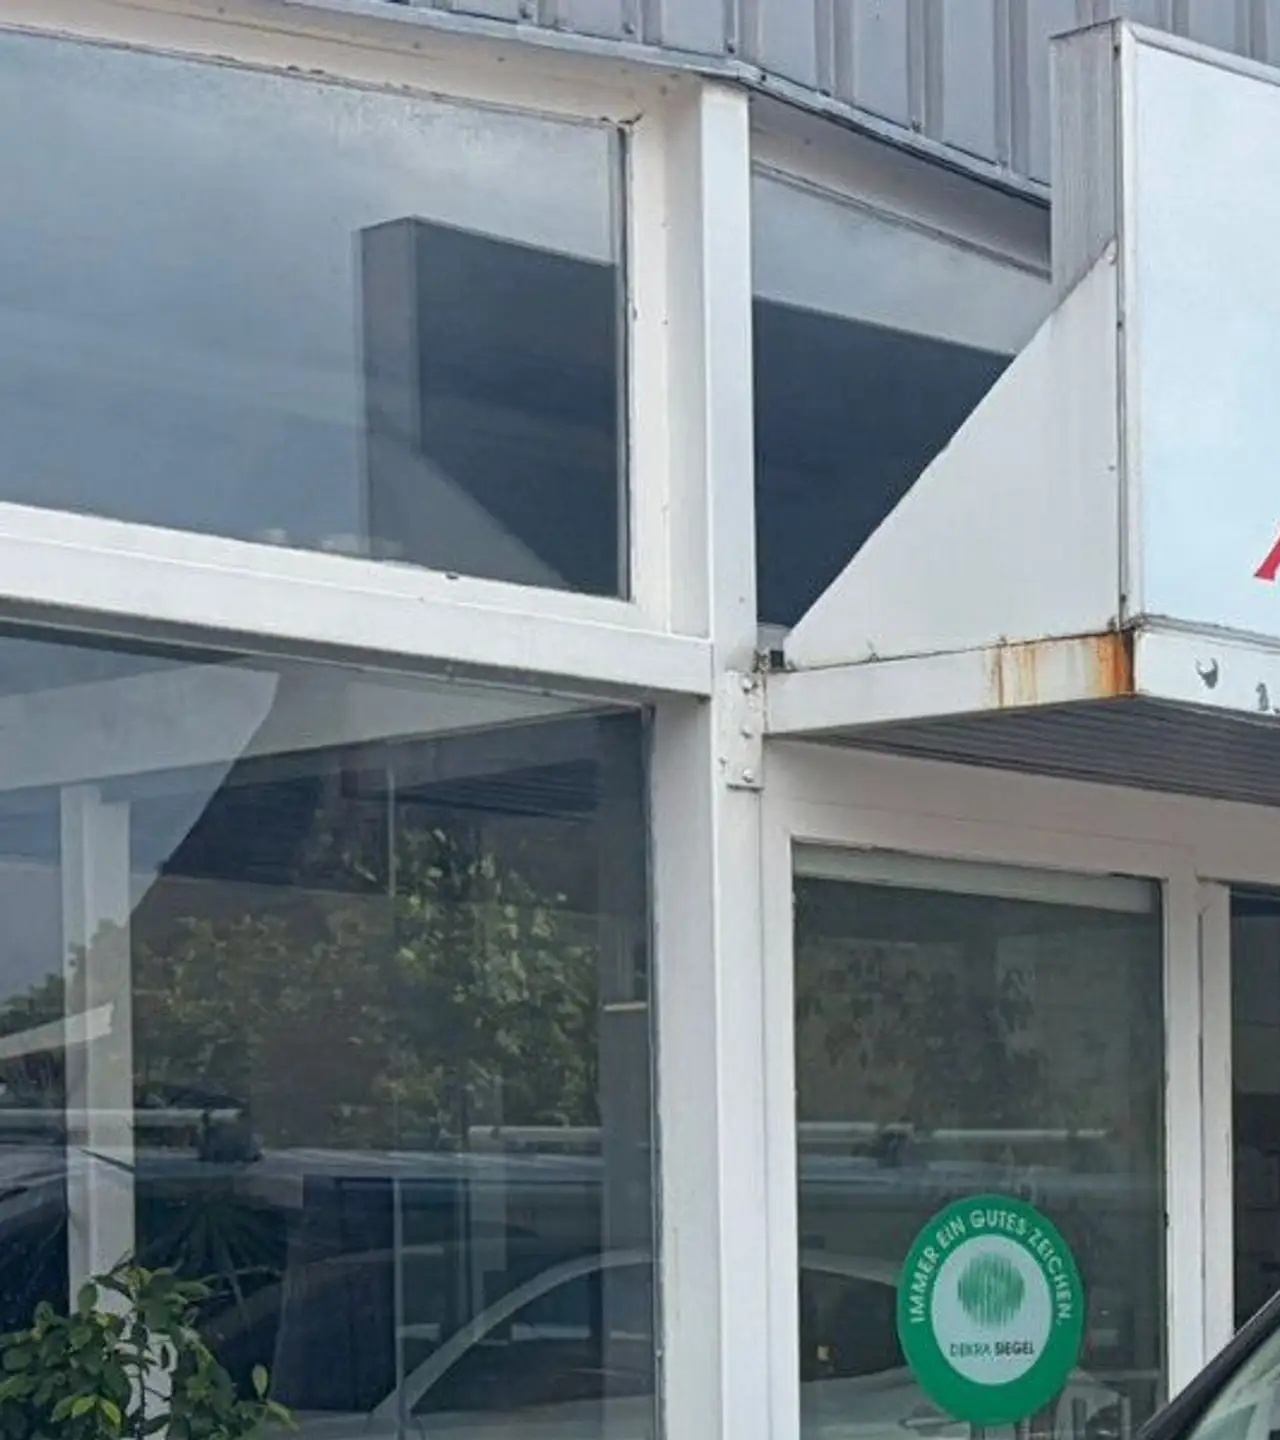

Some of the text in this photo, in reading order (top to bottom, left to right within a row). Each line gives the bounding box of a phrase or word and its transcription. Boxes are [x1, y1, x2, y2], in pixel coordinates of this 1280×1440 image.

[909, 1246, 940, 1323] IMMER
[936, 1216, 967, 1249] EIN
[969, 1209, 1027, 1236] GUTES
[994, 1340, 1036, 1356] SIEGEL
